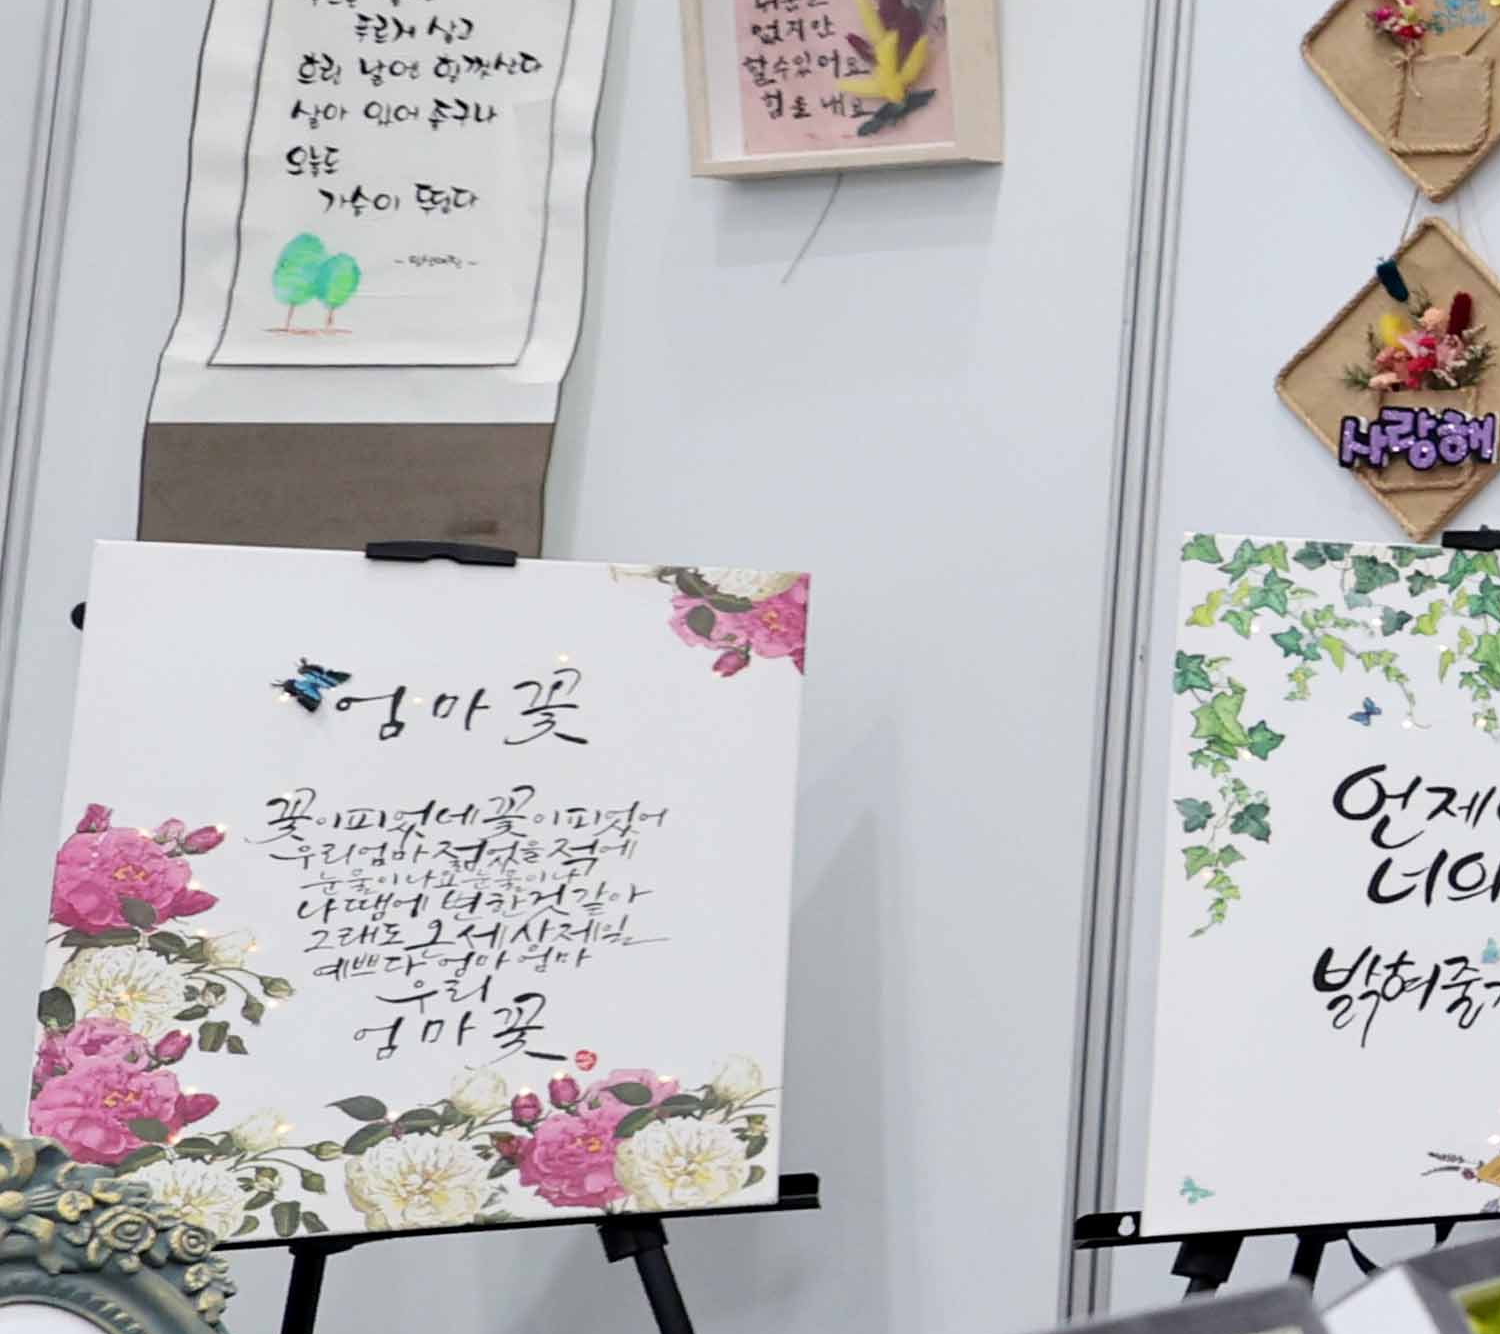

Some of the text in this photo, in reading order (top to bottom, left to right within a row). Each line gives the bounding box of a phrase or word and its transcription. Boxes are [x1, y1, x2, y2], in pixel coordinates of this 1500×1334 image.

[291, 100, 349, 129] 살아
[364, 101, 420, 127] 있어
[286, 146, 340, 177] 오늘도
[1338, 406, 1500, 470] 사랑해
